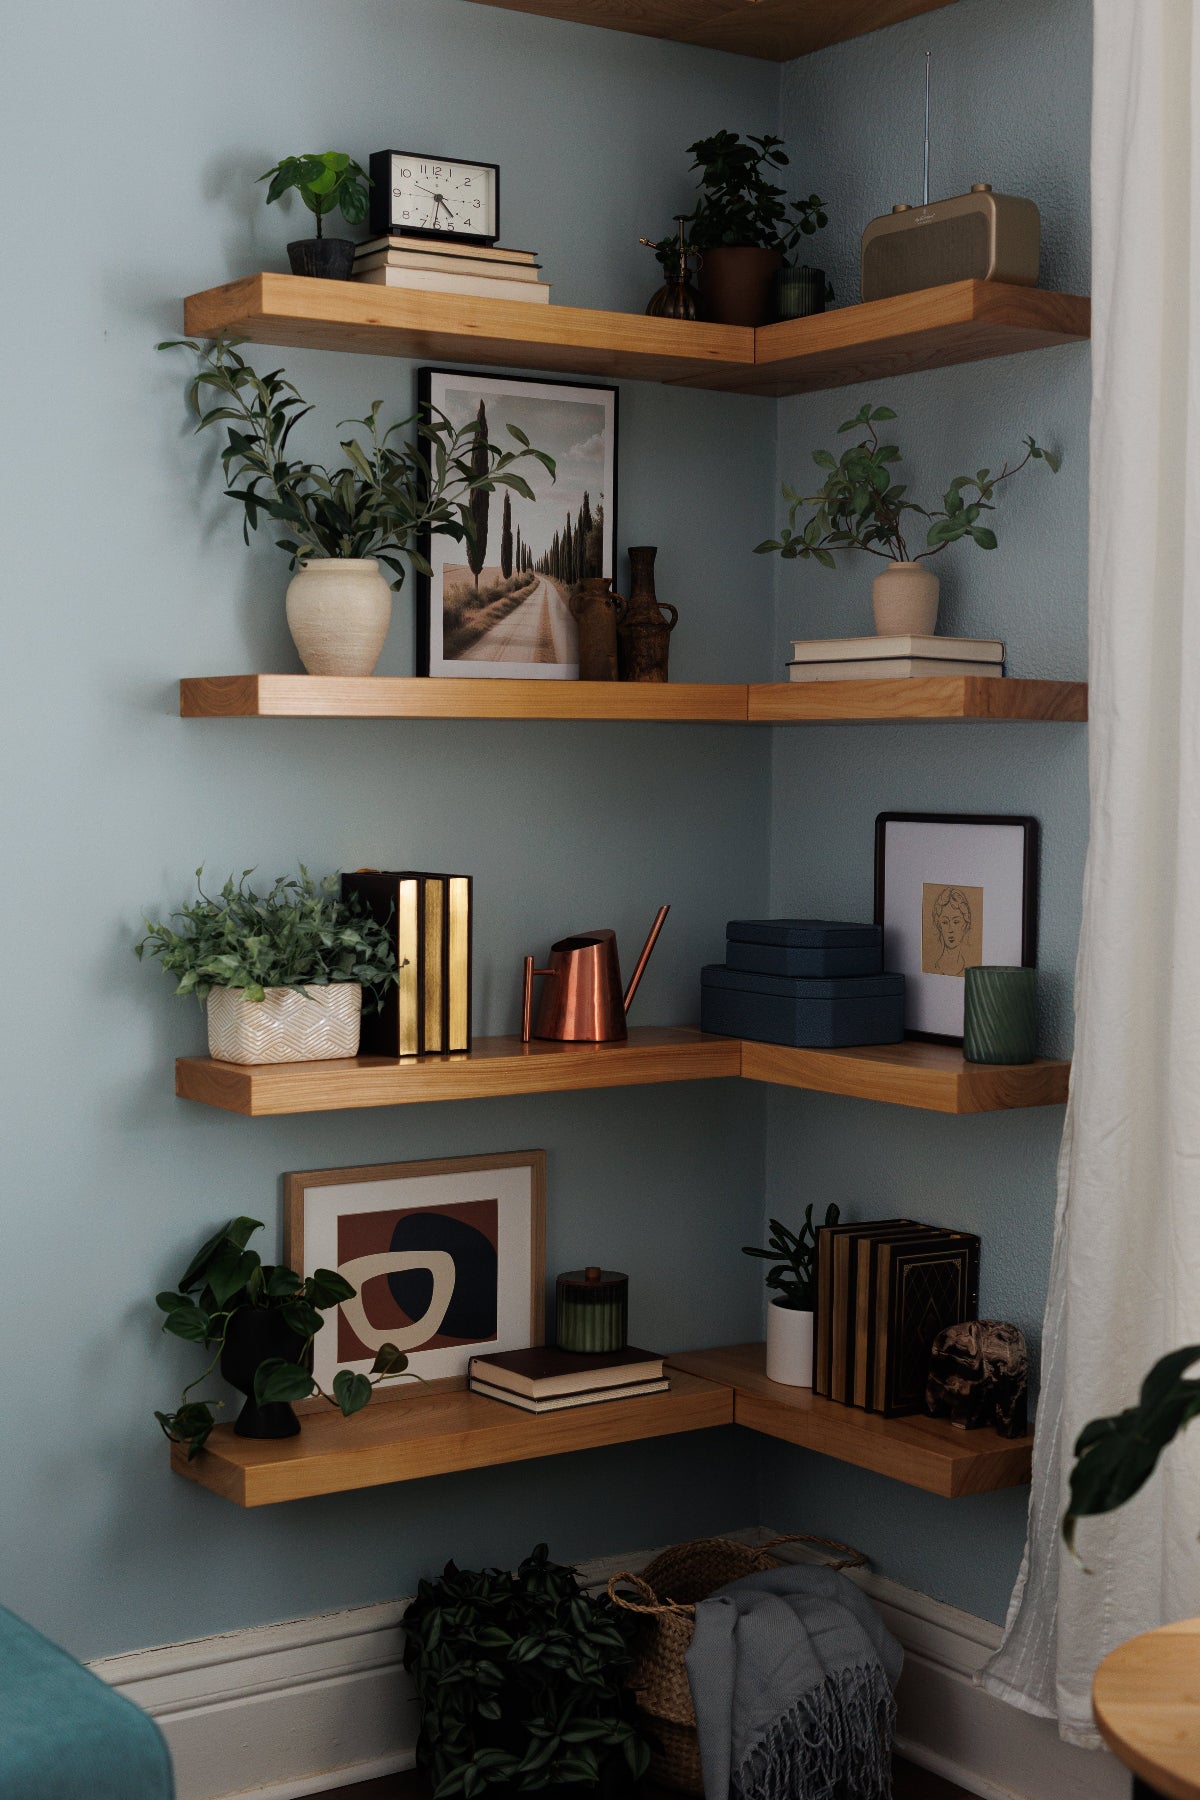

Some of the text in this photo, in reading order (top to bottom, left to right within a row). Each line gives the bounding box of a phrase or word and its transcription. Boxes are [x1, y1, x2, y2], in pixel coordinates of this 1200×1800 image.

[400, 168, 412, 178] 10
[420, 164, 426, 174] 11
[432, 166, 442, 176] 12
[464, 177, 471, 187] 2
[392, 188, 402, 198] 9
[472, 199, 481, 208] 3
[402, 210, 410, 219] 8
[420, 218, 427, 228] 7
[434, 219, 442, 230] 6
[447, 222, 455, 231] 5
[463, 218, 472, 227] 4
